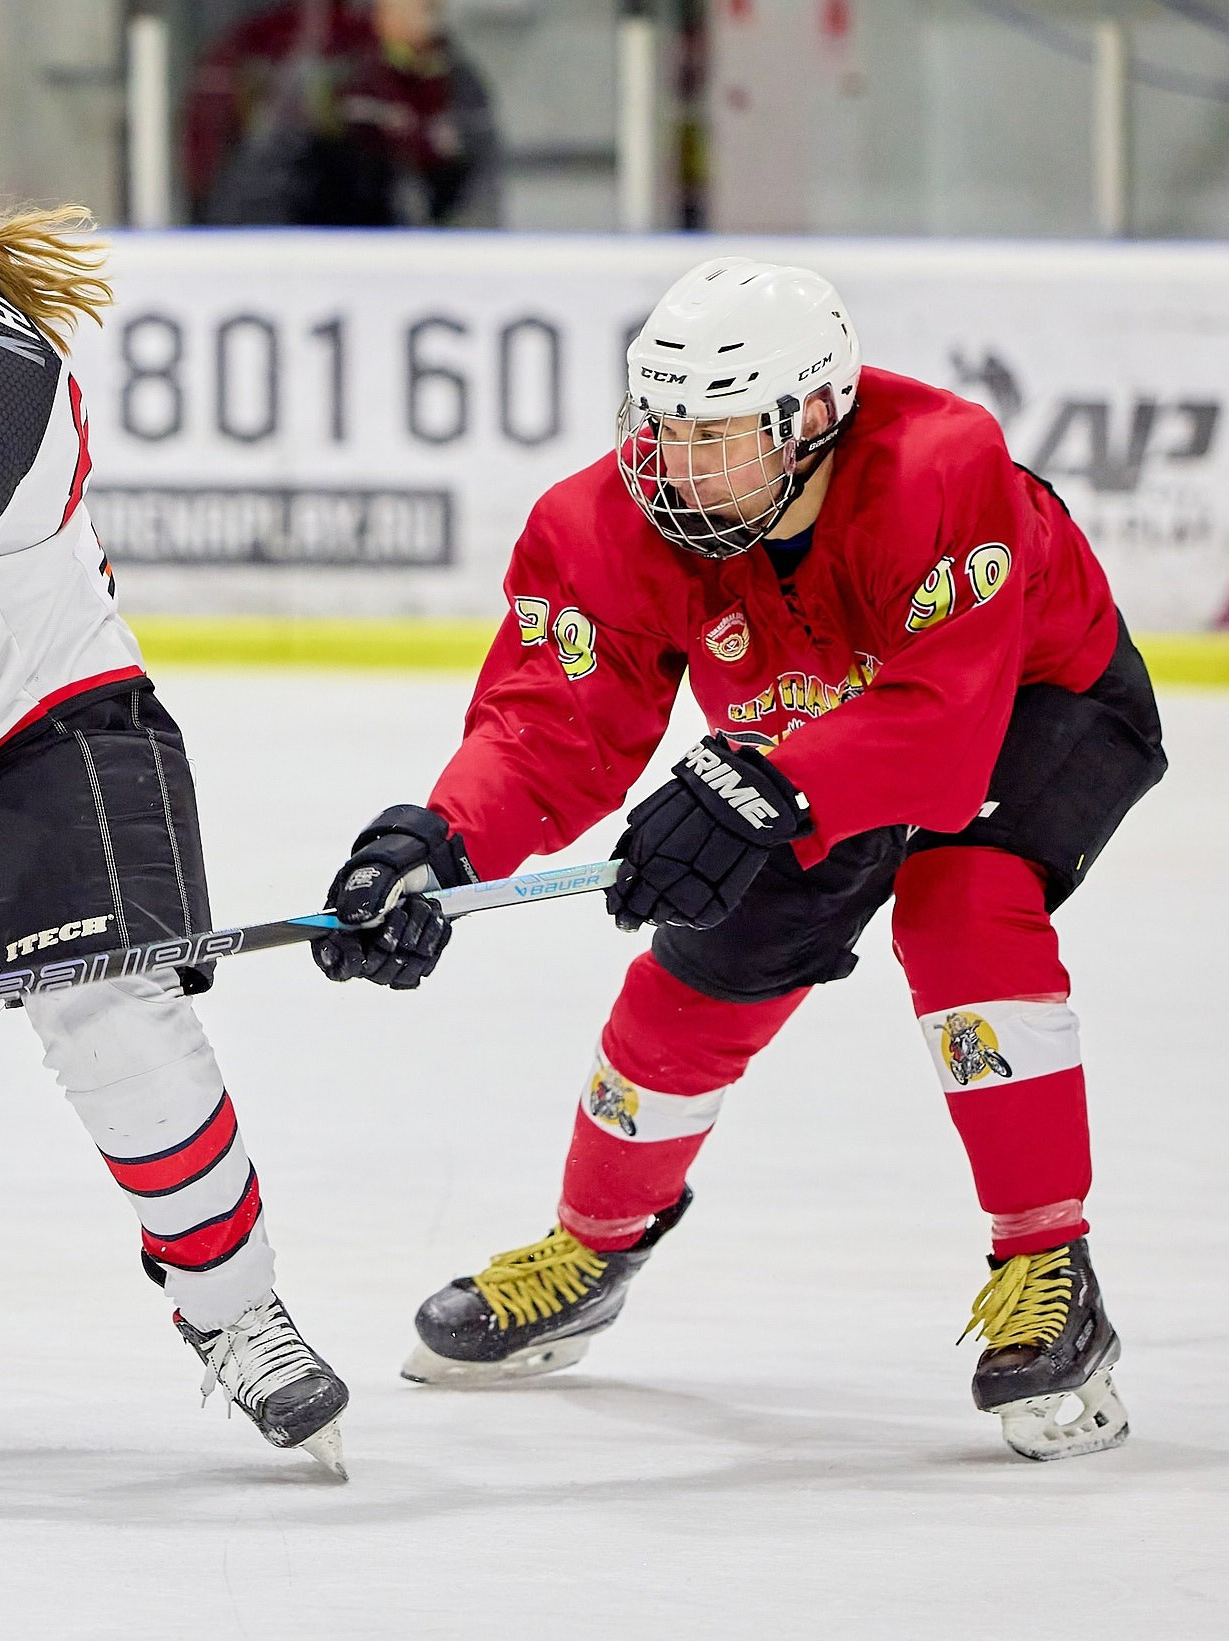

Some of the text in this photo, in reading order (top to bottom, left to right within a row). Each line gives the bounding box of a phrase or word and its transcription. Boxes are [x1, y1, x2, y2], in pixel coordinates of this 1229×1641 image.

[122, 313, 348, 444] 801
[406, 315, 562, 446] 60
[641, 366, 688, 384] CCM
[798, 352, 833, 382] CCM
[808, 428, 839, 452] BAUER
[679, 742, 780, 830] PRIME
[530, 874, 601, 897] BAUER
[5, 913, 110, 962] ITECH
